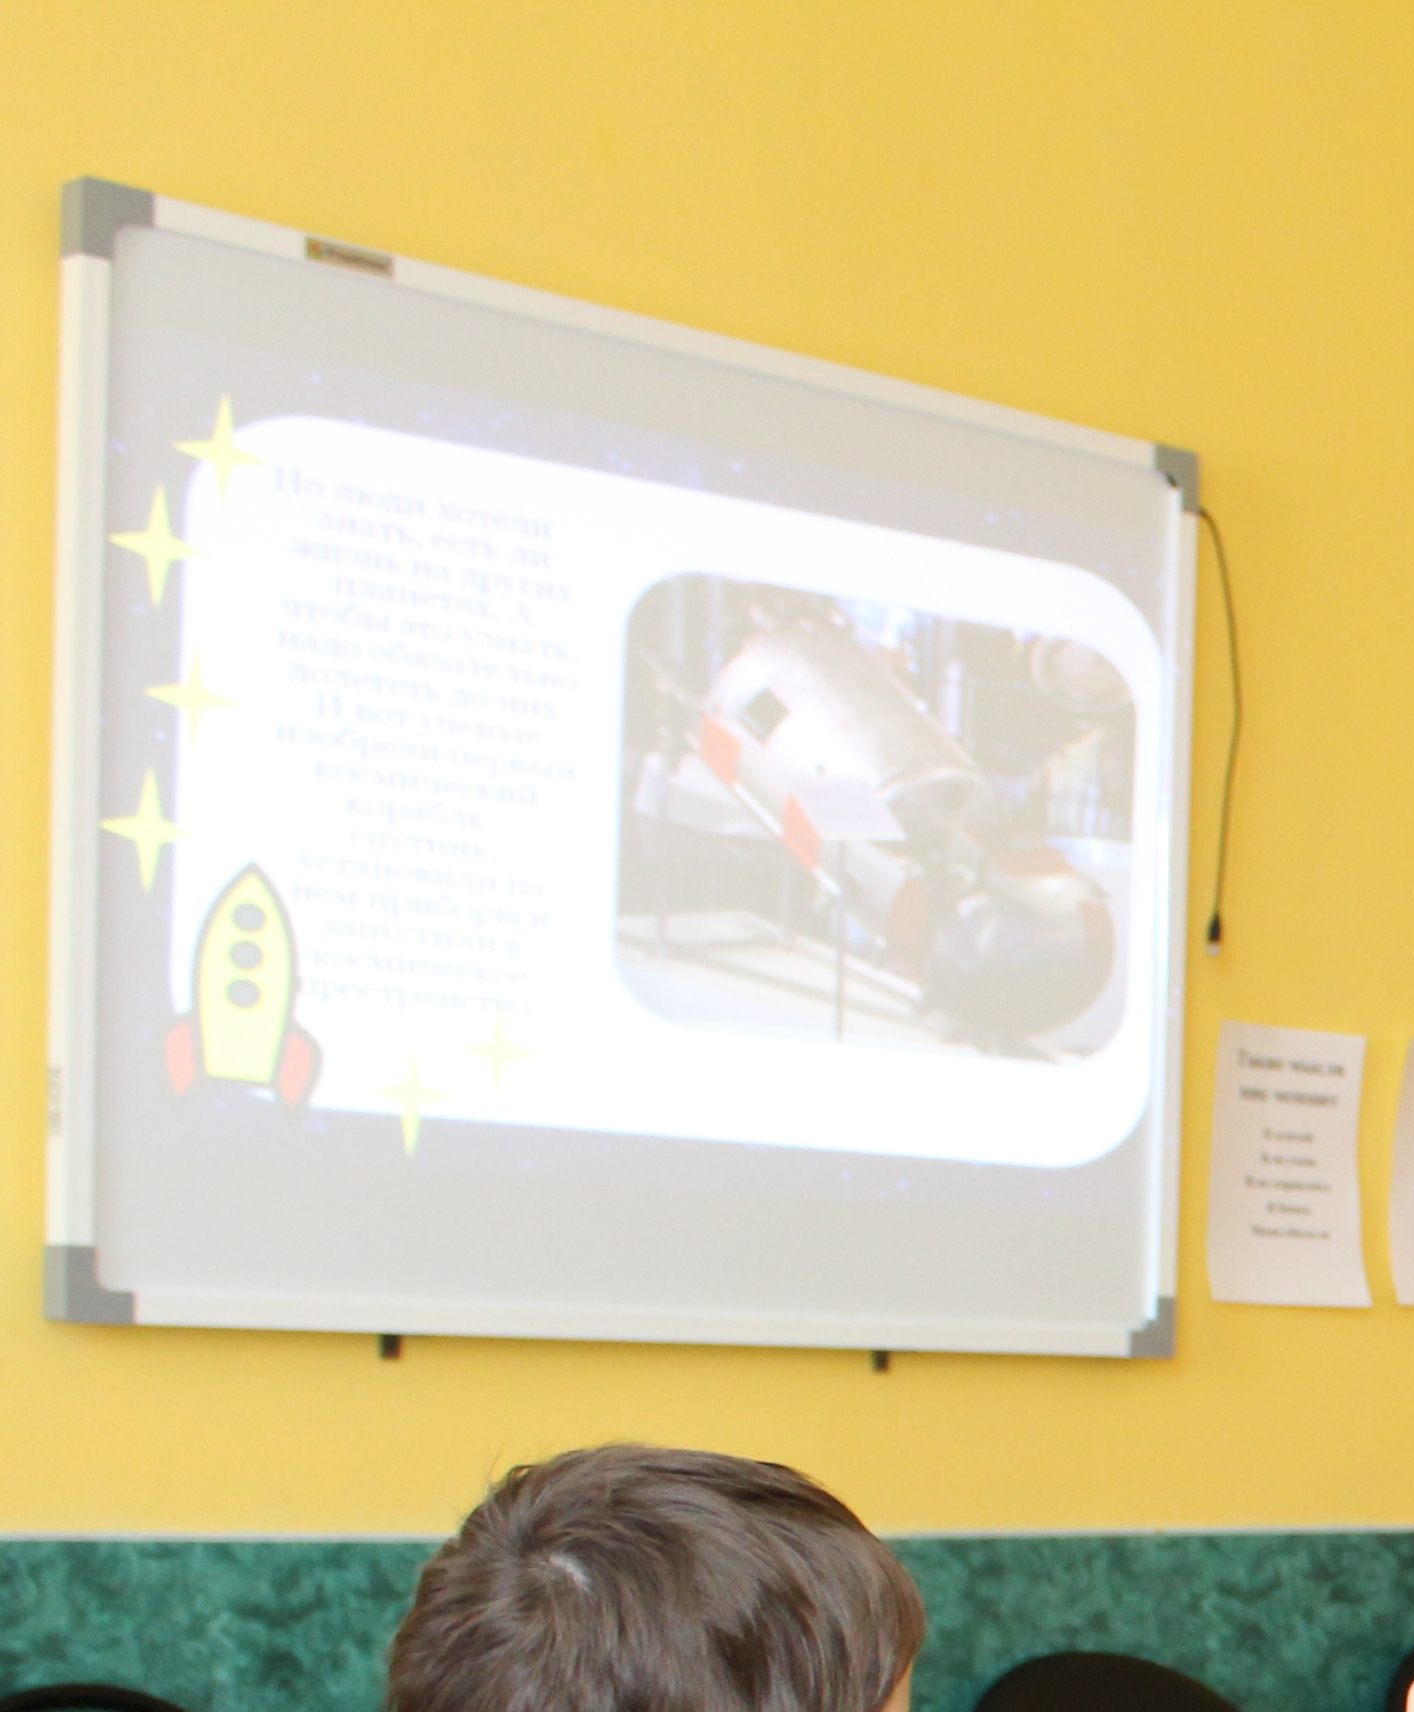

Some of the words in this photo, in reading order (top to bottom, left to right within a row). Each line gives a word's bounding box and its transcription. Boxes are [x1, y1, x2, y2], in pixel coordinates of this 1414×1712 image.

[273, 466, 324, 495] Но
[335, 481, 427, 518] люди
[436, 501, 552, 540] хотели
